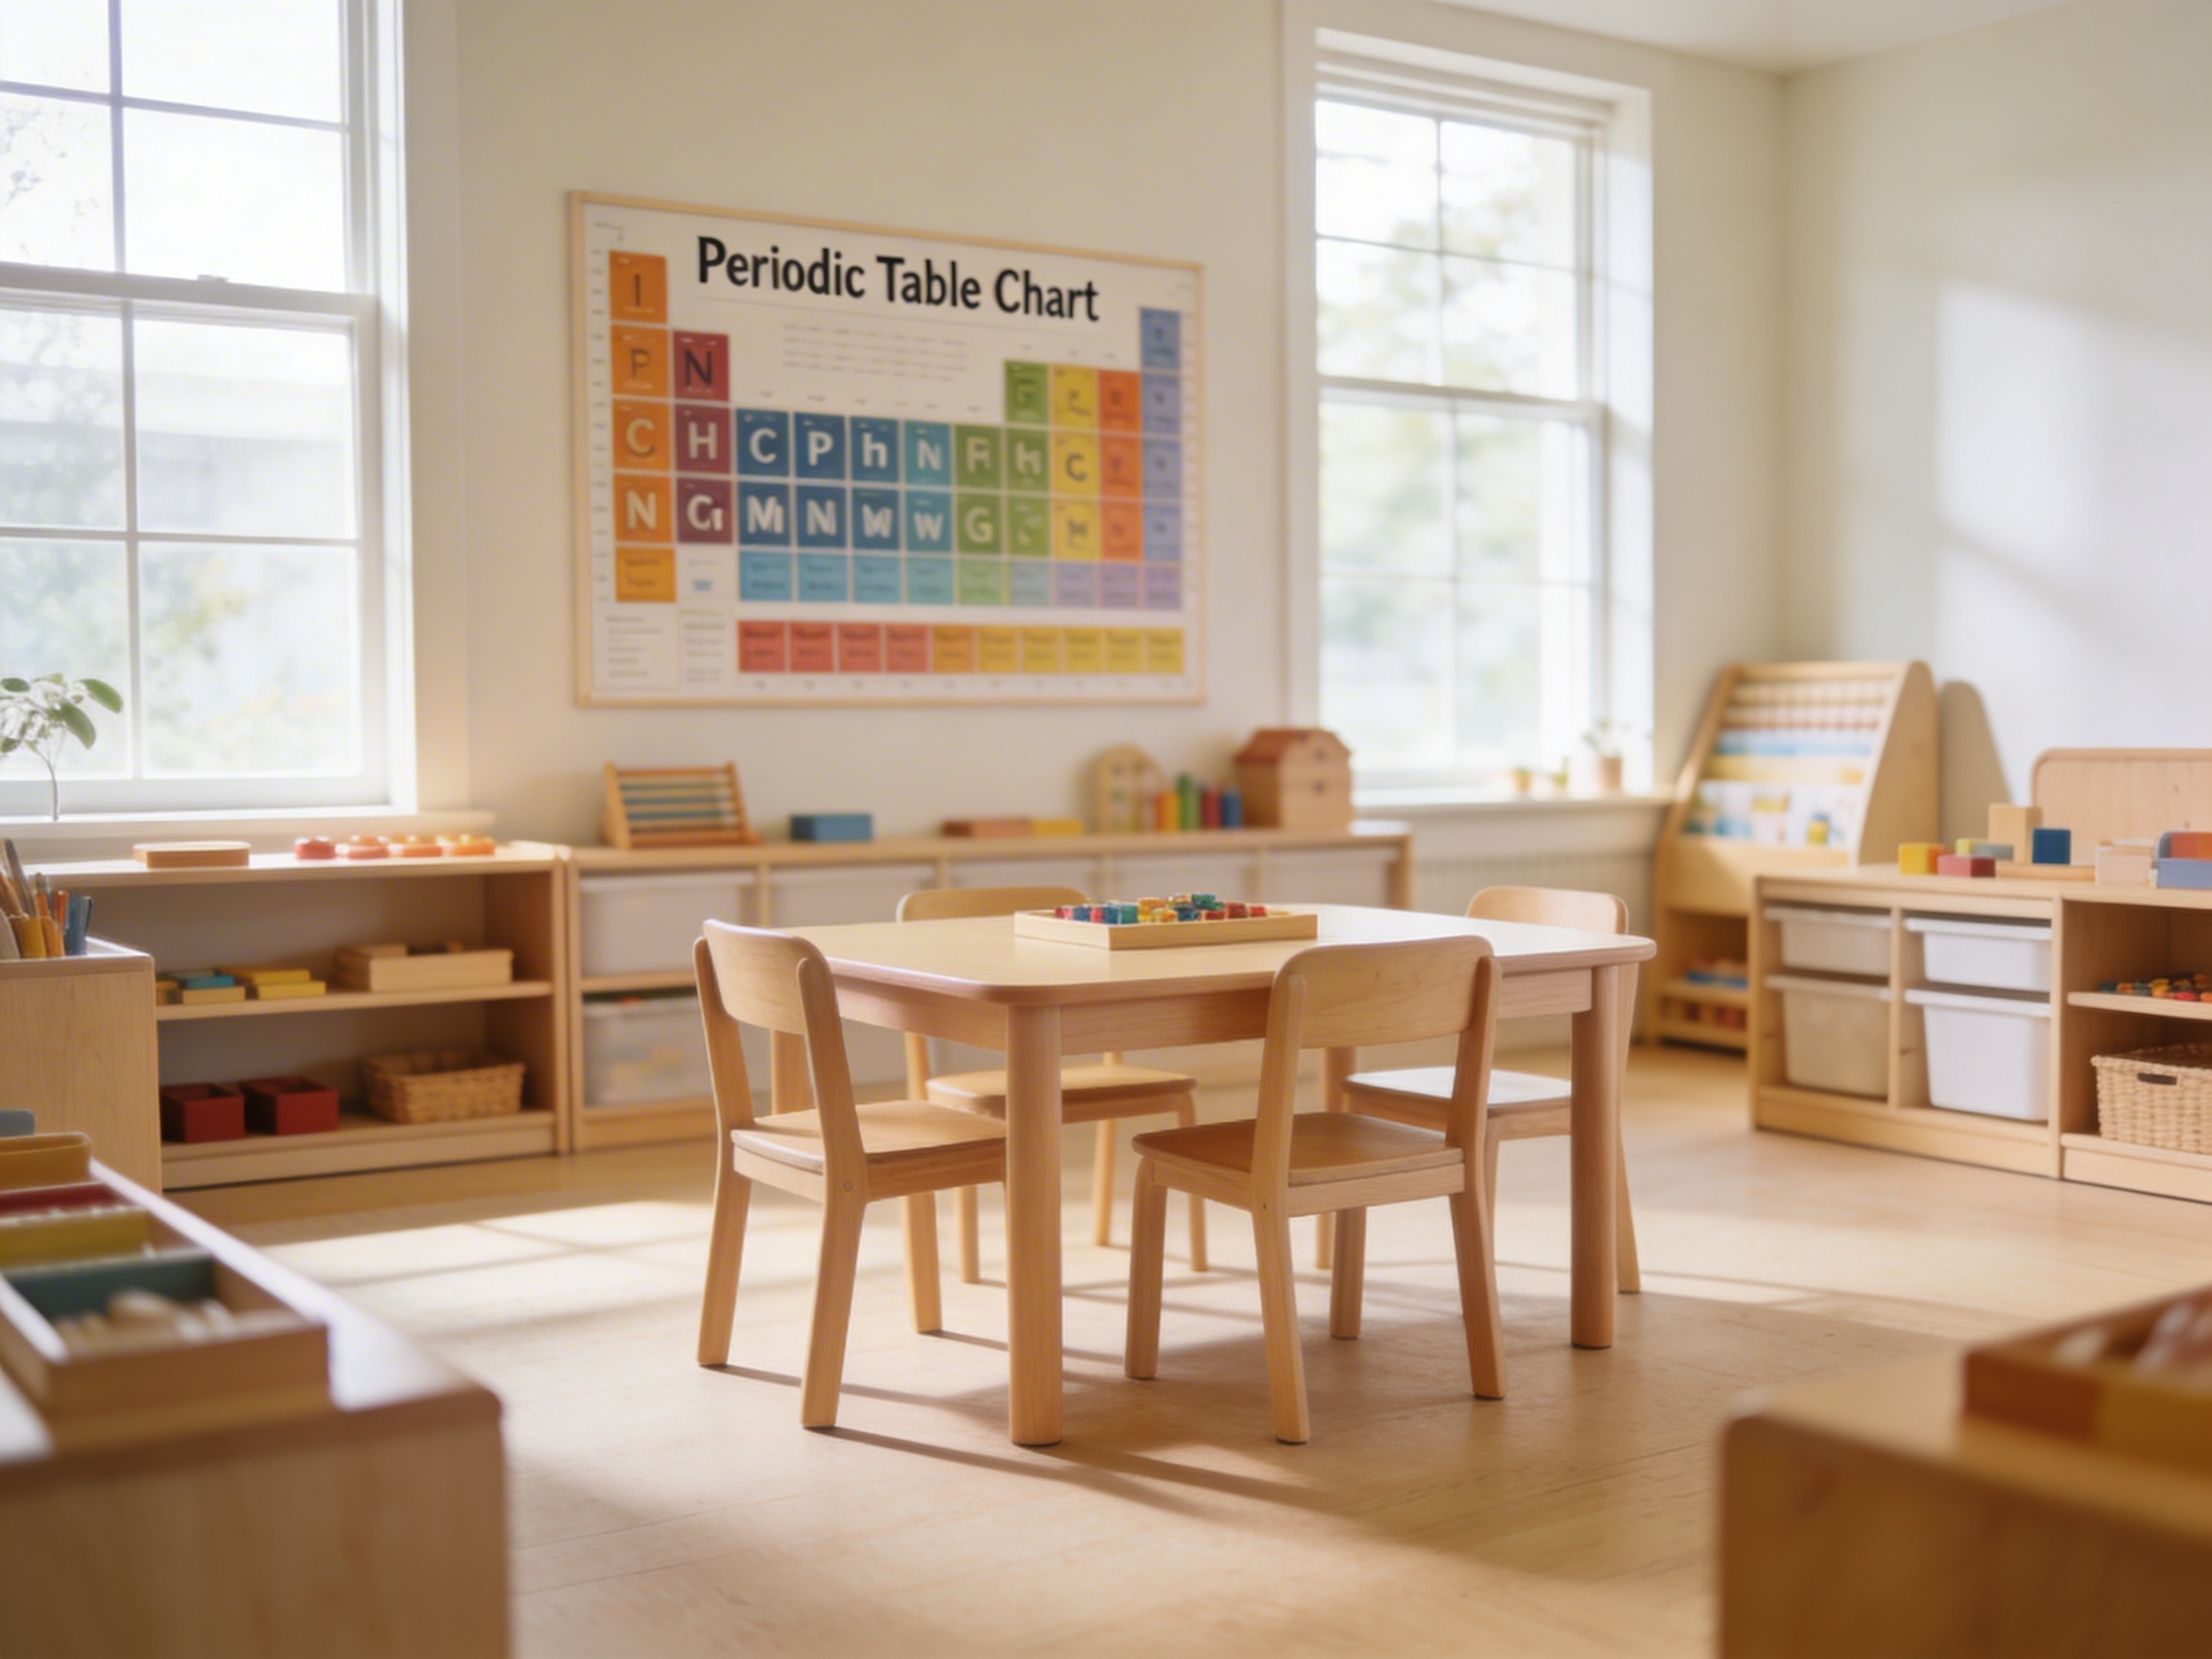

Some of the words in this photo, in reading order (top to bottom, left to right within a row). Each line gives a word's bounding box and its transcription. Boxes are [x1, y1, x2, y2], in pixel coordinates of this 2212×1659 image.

[697, 235, 865, 299] Periodic
[876, 254, 981, 309] Table
[995, 268, 1099, 322] Chart
[630, 348, 650, 379] P
[685, 348, 712, 387] N
[626, 418, 656, 458] C
[688, 421, 718, 460] H
[750, 427, 777, 464] C
[808, 430, 833, 467] P
[917, 440, 941, 470] N
[1066, 452, 1088, 482] C
[627, 490, 657, 530] N
[965, 507, 994, 543] G
